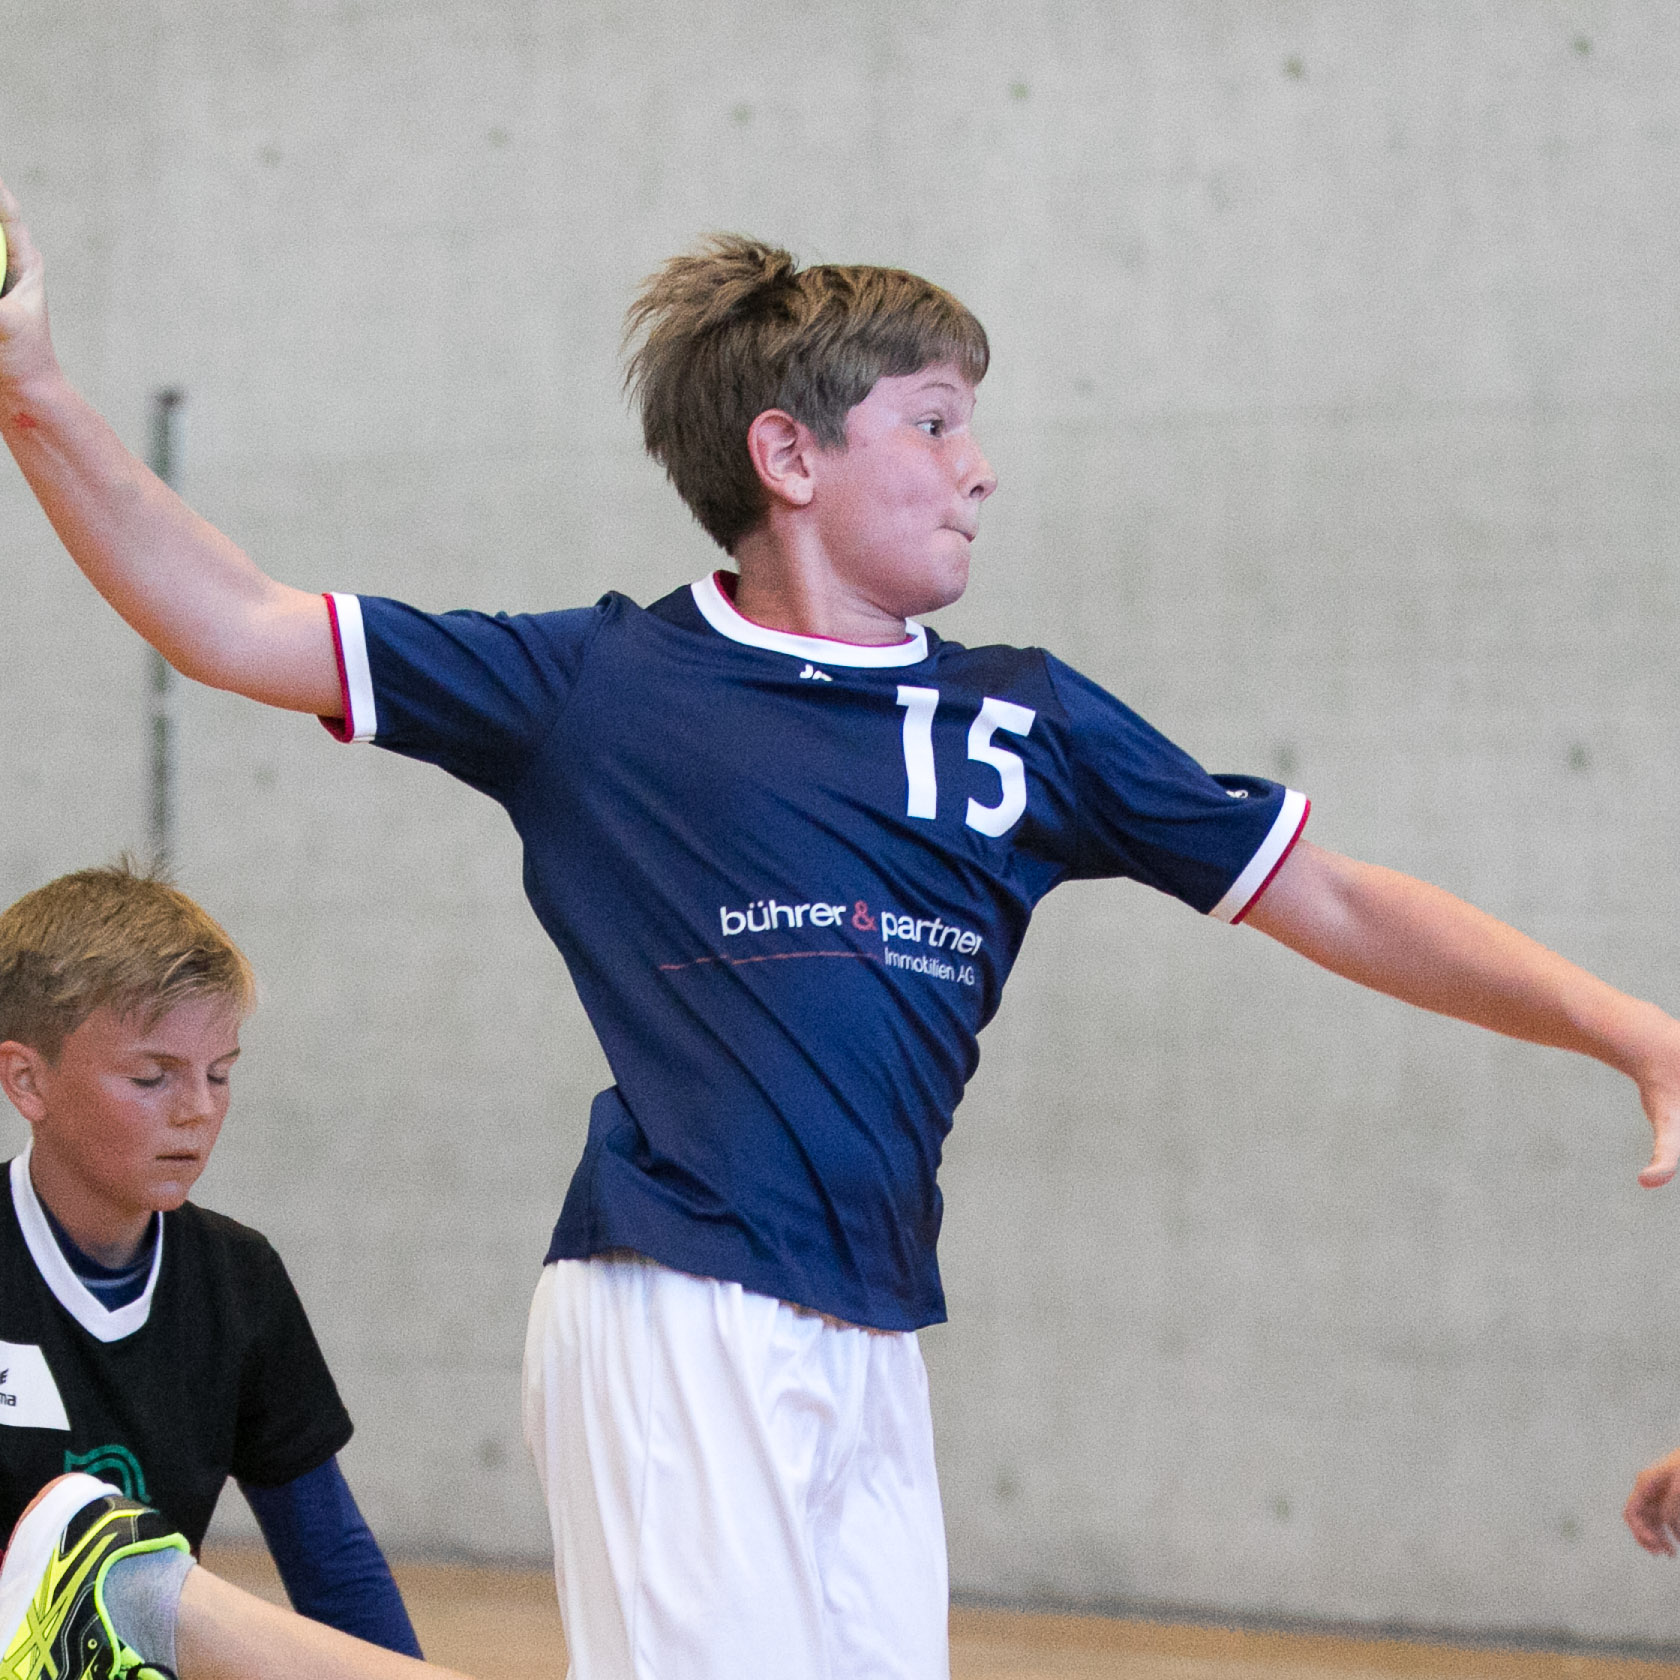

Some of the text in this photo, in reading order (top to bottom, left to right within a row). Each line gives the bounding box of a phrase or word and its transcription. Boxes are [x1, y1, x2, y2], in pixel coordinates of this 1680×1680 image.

[897, 685, 1036, 838] 15
[720, 899, 983, 956] bührer & partner
[884, 947, 975, 986] Immobilien AG
